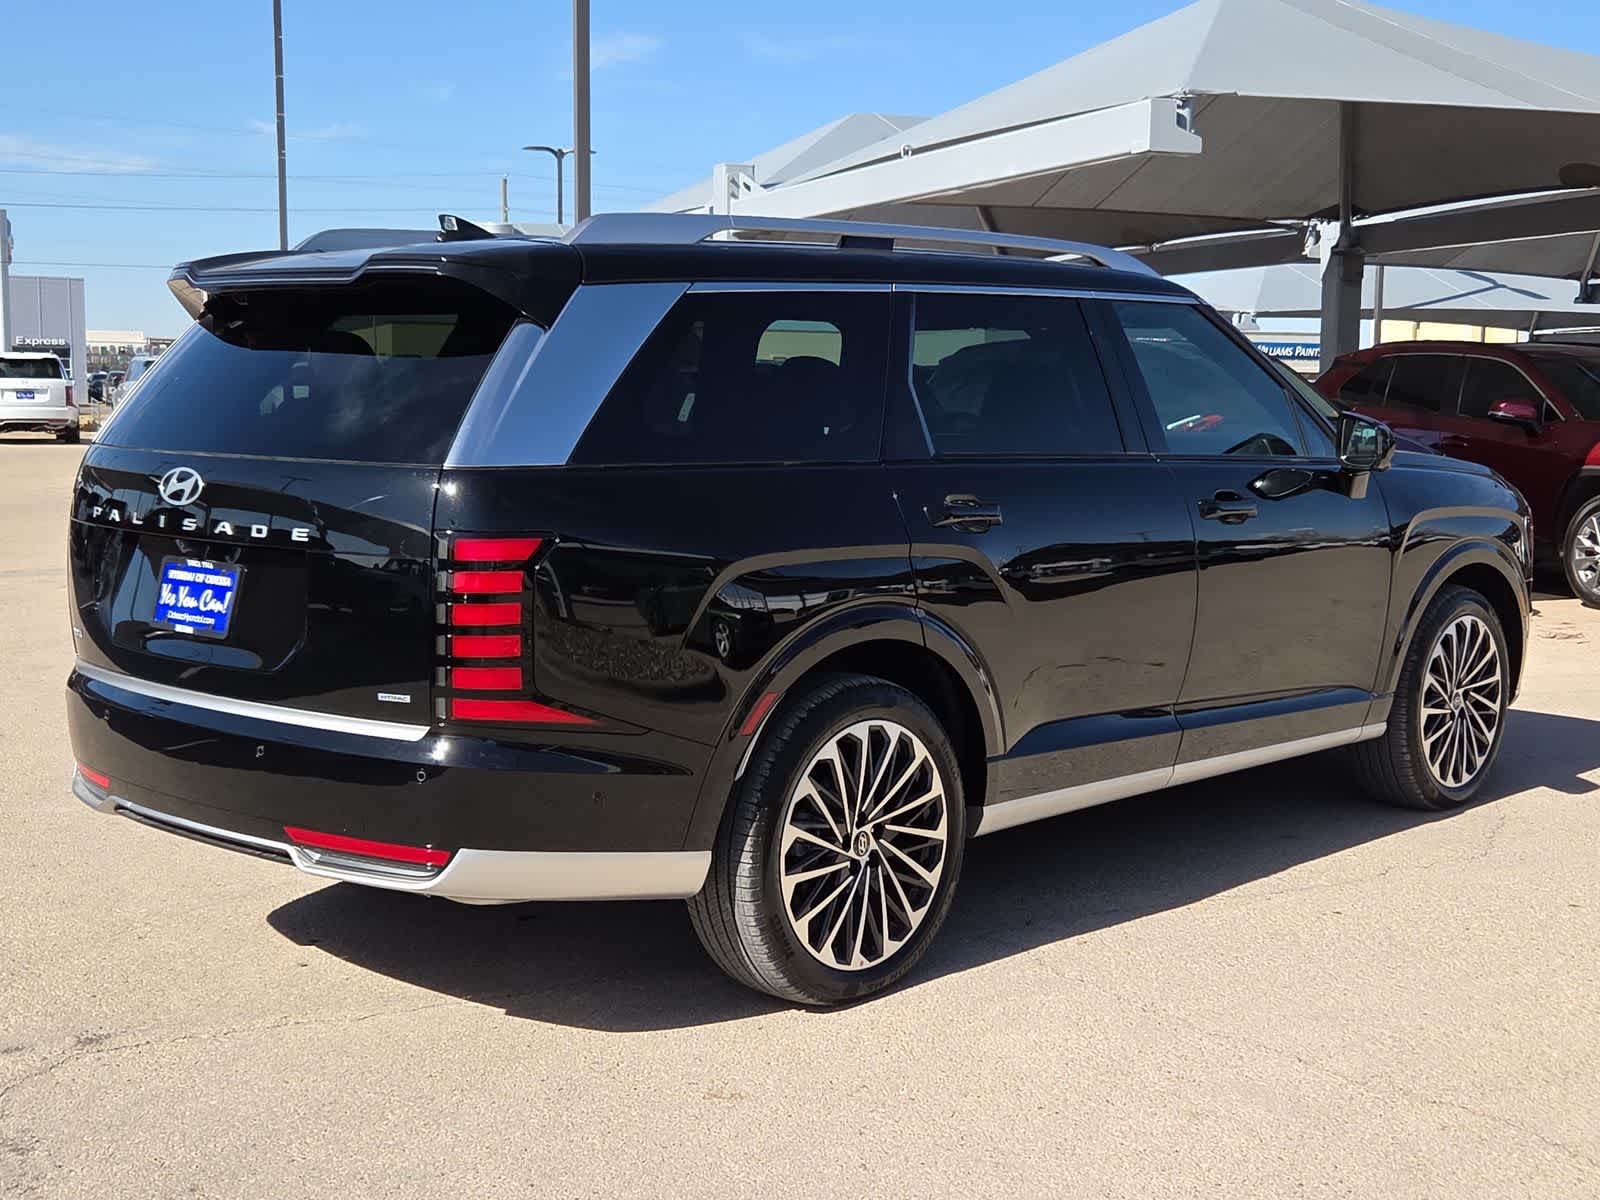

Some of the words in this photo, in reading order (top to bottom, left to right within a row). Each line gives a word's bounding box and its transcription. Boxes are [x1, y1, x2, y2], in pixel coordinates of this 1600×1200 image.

[15, 336, 66, 347] Express
[92, 506, 310, 542] PALISADE
[159, 583, 176, 606] Yes
[177, 586, 198, 608] You
[199, 589, 233, 614] Can!
